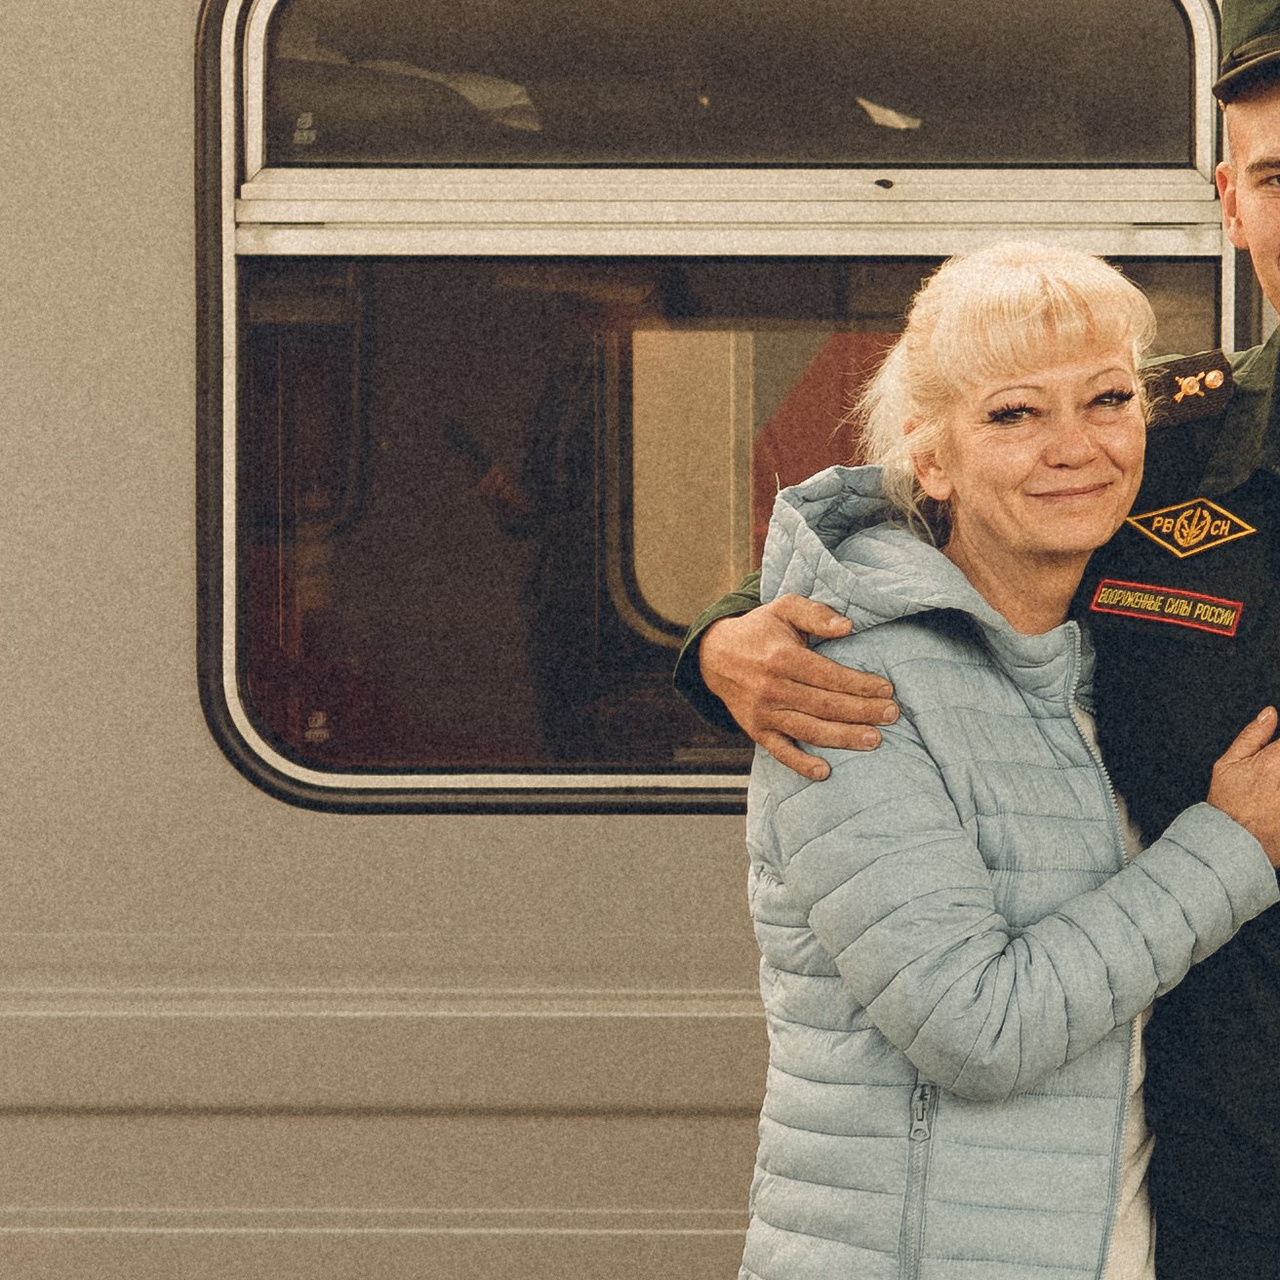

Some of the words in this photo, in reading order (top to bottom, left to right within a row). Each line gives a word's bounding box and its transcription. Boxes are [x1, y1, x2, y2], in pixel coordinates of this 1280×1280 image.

[1097, 587, 1165, 612] ВООРУЖЕННЫЕ
[1164, 597, 1193, 617] СИЛЫ
[1193, 603, 1237, 626] РОССИИ
